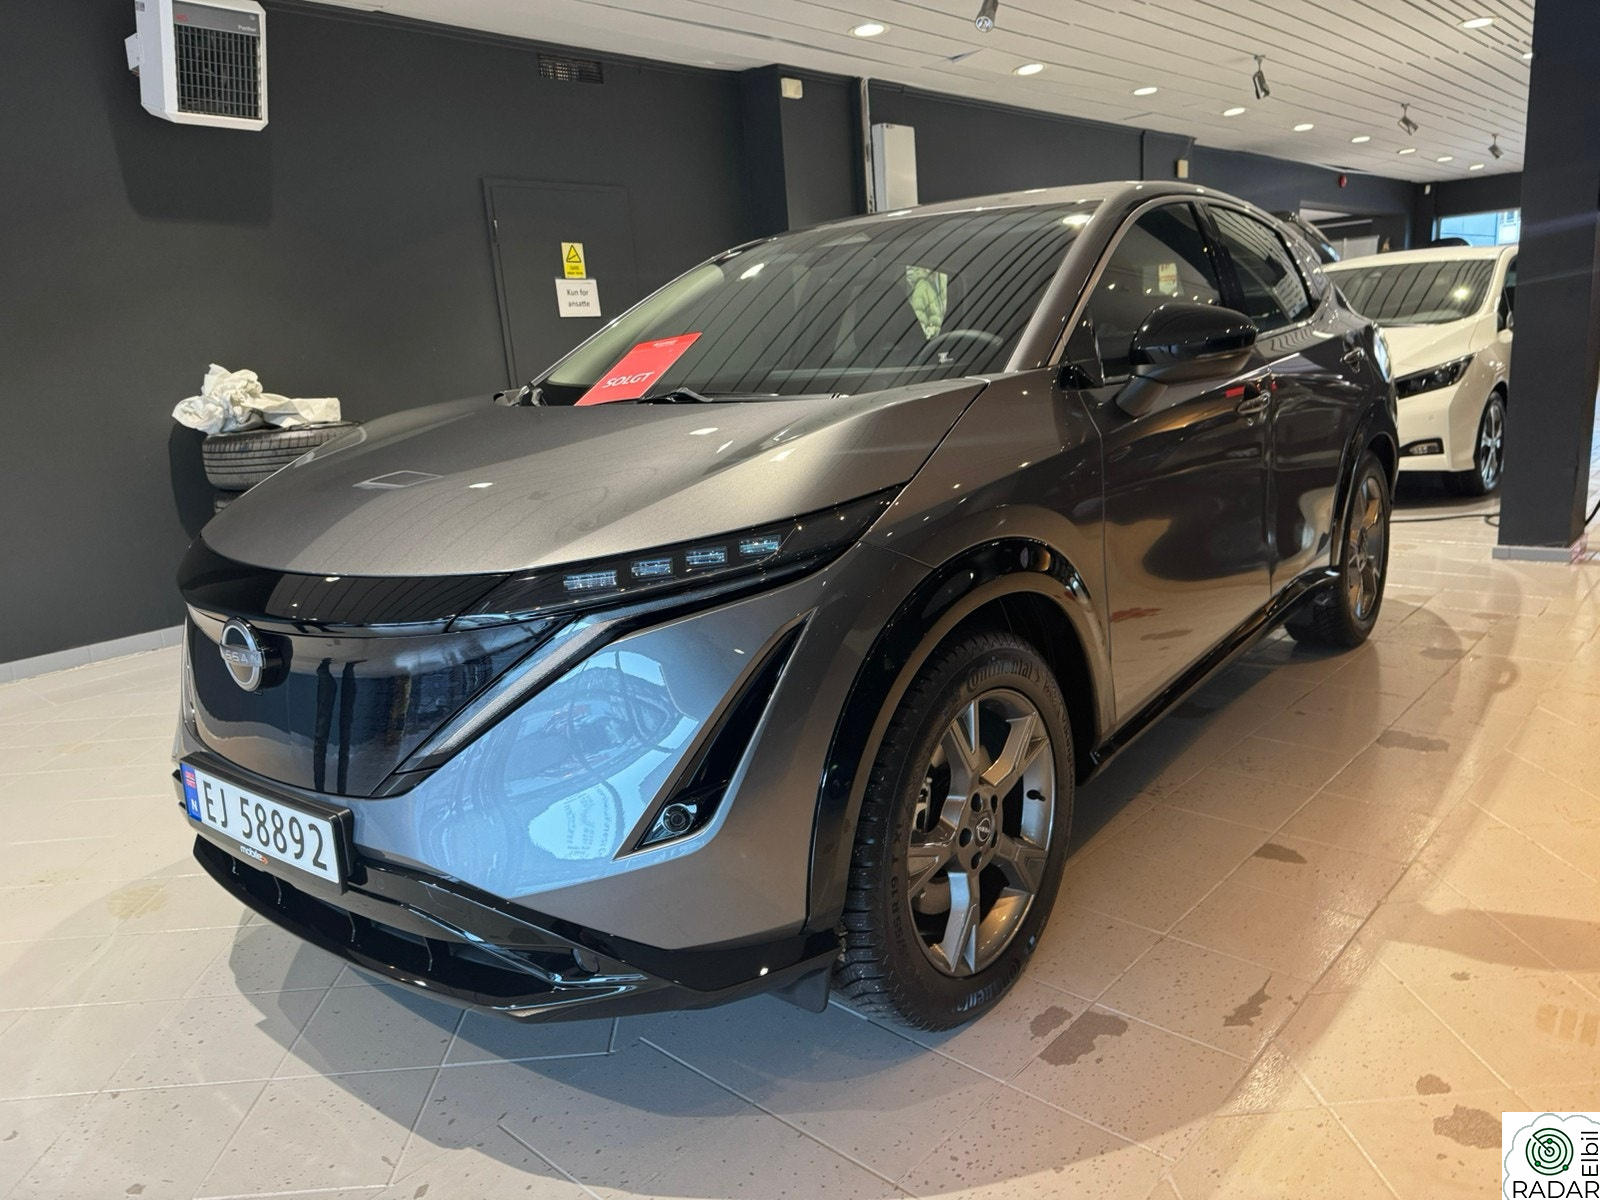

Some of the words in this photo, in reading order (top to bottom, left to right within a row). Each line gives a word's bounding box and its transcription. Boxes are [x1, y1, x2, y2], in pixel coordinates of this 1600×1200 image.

[580, 288, 589, 296] for
[602, 371, 655, 389] SOLGT
[191, 798, 199, 812] N
[203, 780, 228, 829] EJ
[239, 796, 328, 871] 58892
